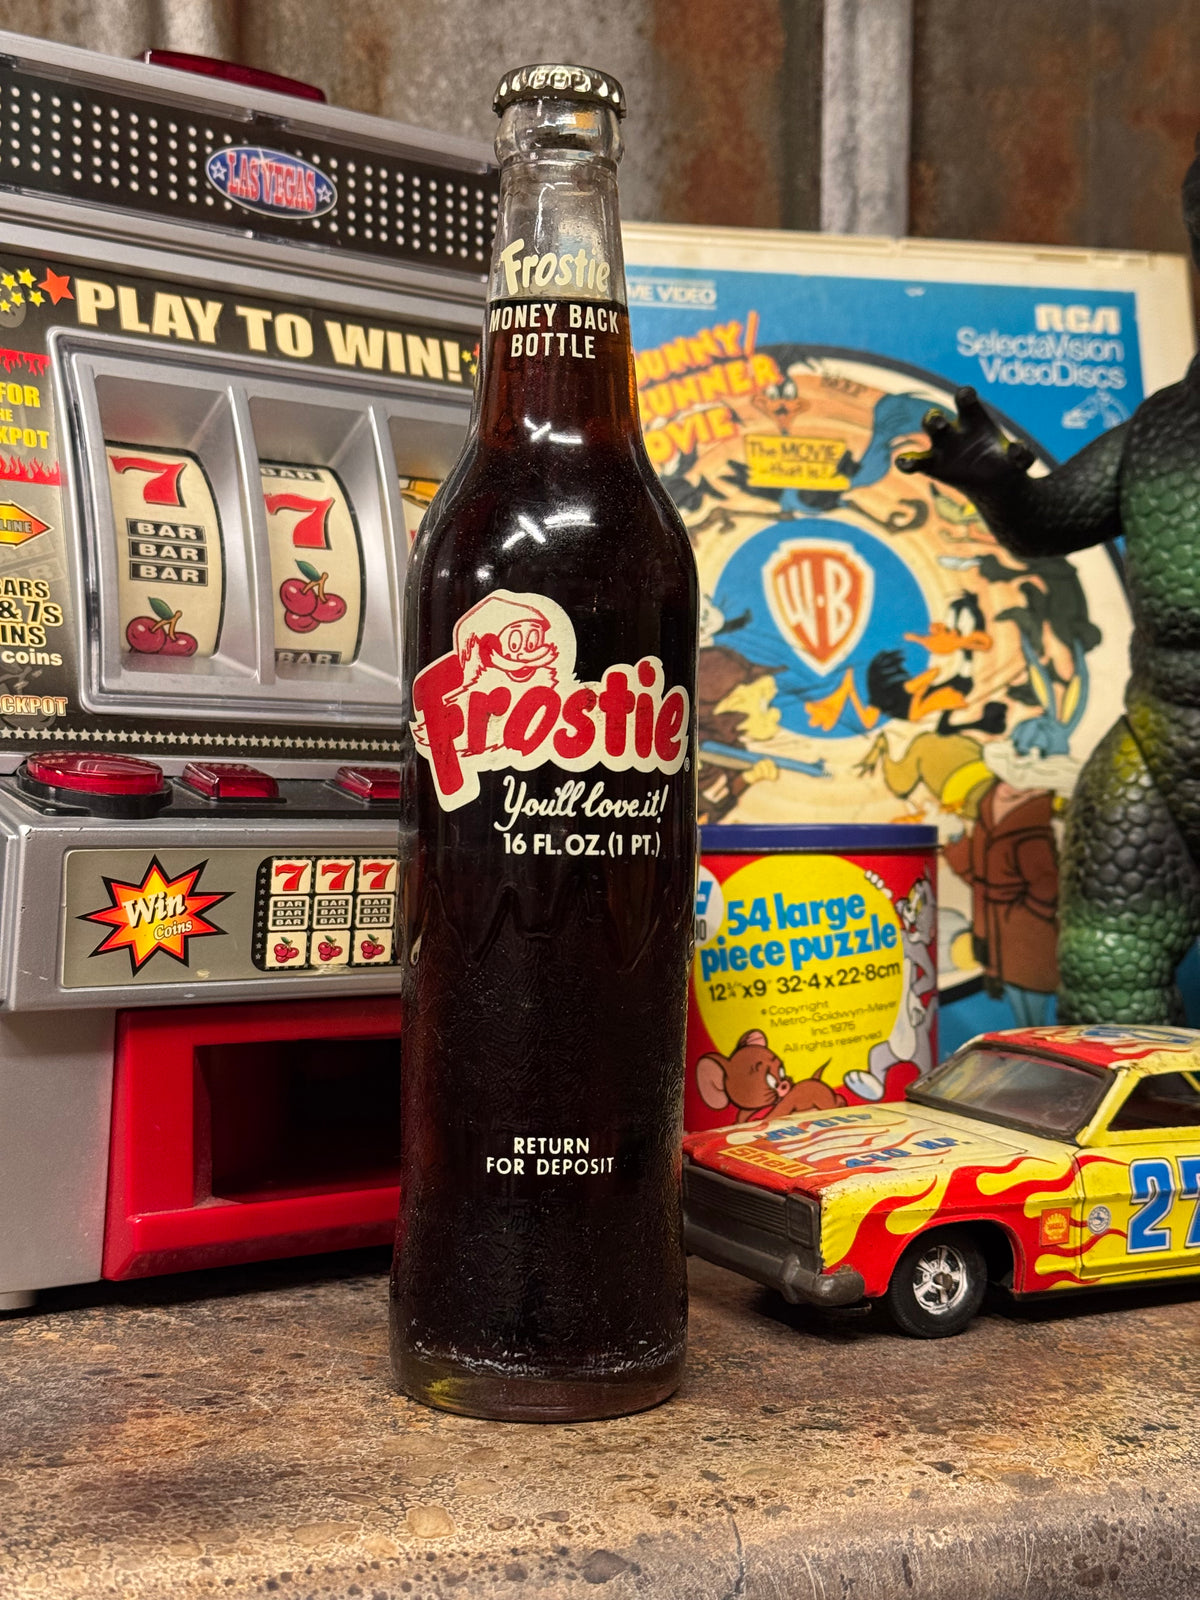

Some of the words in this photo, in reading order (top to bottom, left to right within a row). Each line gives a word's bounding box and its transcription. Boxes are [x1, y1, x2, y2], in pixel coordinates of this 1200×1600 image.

[227, 151, 260, 201] LAS
[260, 161, 317, 213] VEGAS
[500, 238, 611, 295] Frostie
[657, 285, 717, 305] VIDEO
[74, 278, 224, 344] PLAY
[235, 305, 314, 359] TO
[324, 320, 464, 383] WIN!
[488, 304, 557, 334] MONEY
[569, 303, 620, 335] BACK
[1035, 304, 1122, 335] RCA
[510, 332, 597, 360] BOTTLE
[956, 327, 1126, 363] SelectaVision
[978, 356, 1128, 390] VideoDiscs
[109, 455, 188, 507] 7
[138, 523, 198, 540] BAR
[264, 493, 336, 550] 7
[138, 543, 200, 562] BAR
[139, 564, 200, 583] BAR
[0, 577, 50, 599] ARS
[24, 598, 63, 626] 7S
[1, 648, 64, 666] coins
[411, 654, 686, 797] Frostie
[493, 774, 586, 832] You'll
[581, 780, 640, 818] love
[638, 784, 670, 824] it!
[503, 832, 527, 855] 16
[533, 833, 563, 856] FL.
[565, 834, 607, 856] OZ.
[608, 832, 623, 858] (1
[631, 831, 661, 858] PT.)
[274, 863, 309, 892] 7
[321, 862, 355, 891] 7
[362, 862, 396, 890] 7
[122, 891, 188, 929] Win
[276, 909, 302, 917] BAR
[320, 908, 346, 916] BAR
[363, 907, 388, 915] BAR
[321, 899, 347, 907] BAR
[727, 897, 771, 937] 54
[773, 892, 866, 932] large
[153, 920, 193, 941] Coins
[319, 917, 345, 925] BAR
[700, 935, 786, 983] piece
[789, 913, 898, 972] puzzle
[824, 976, 836, 989] x
[768, 999, 830, 1017] Copyright
[783, 1042, 799, 1053] All
[800, 1038, 834, 1053] rights
[835, 1030, 883, 1047] reserved
[513, 1136, 590, 1155] RETURN
[486, 1156, 525, 1175] FOR
[536, 1157, 615, 1176] DEPOSIT
[726, 1146, 812, 1175] Shell
